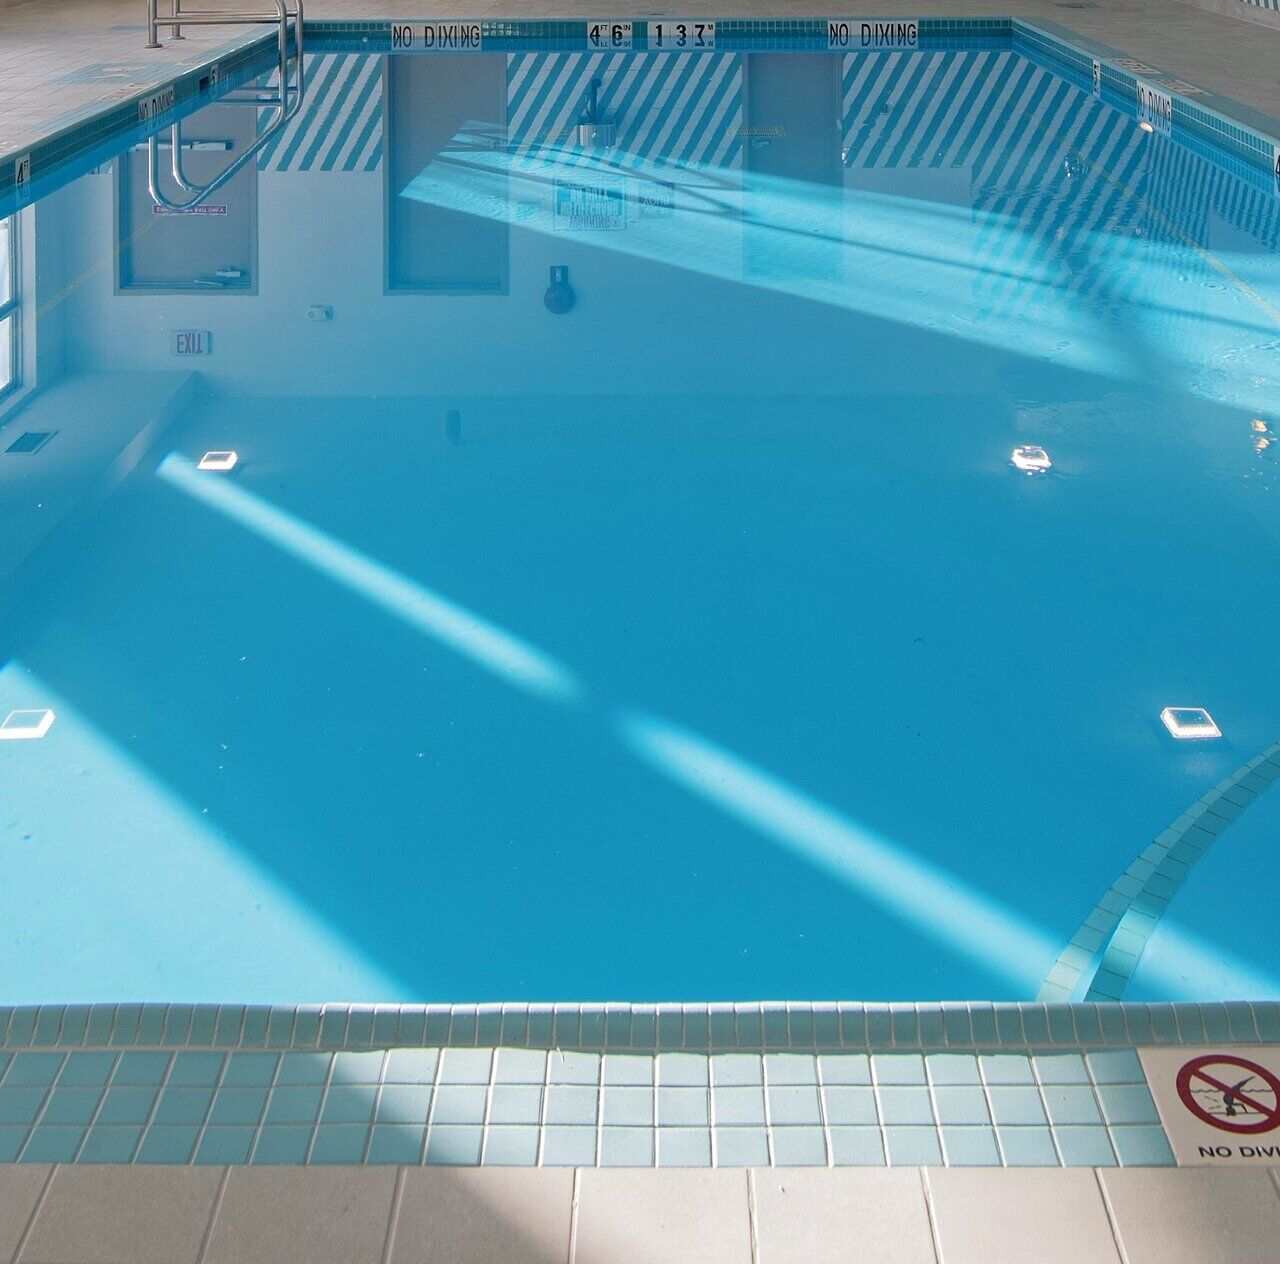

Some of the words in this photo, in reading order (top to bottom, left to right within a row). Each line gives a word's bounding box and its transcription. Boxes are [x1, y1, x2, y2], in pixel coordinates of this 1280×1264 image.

[393, 26, 412, 41] NO
[590, 25, 600, 38] 4
[830, 24, 848, 40] NO
[1197, 1146, 1232, 1158] NO
